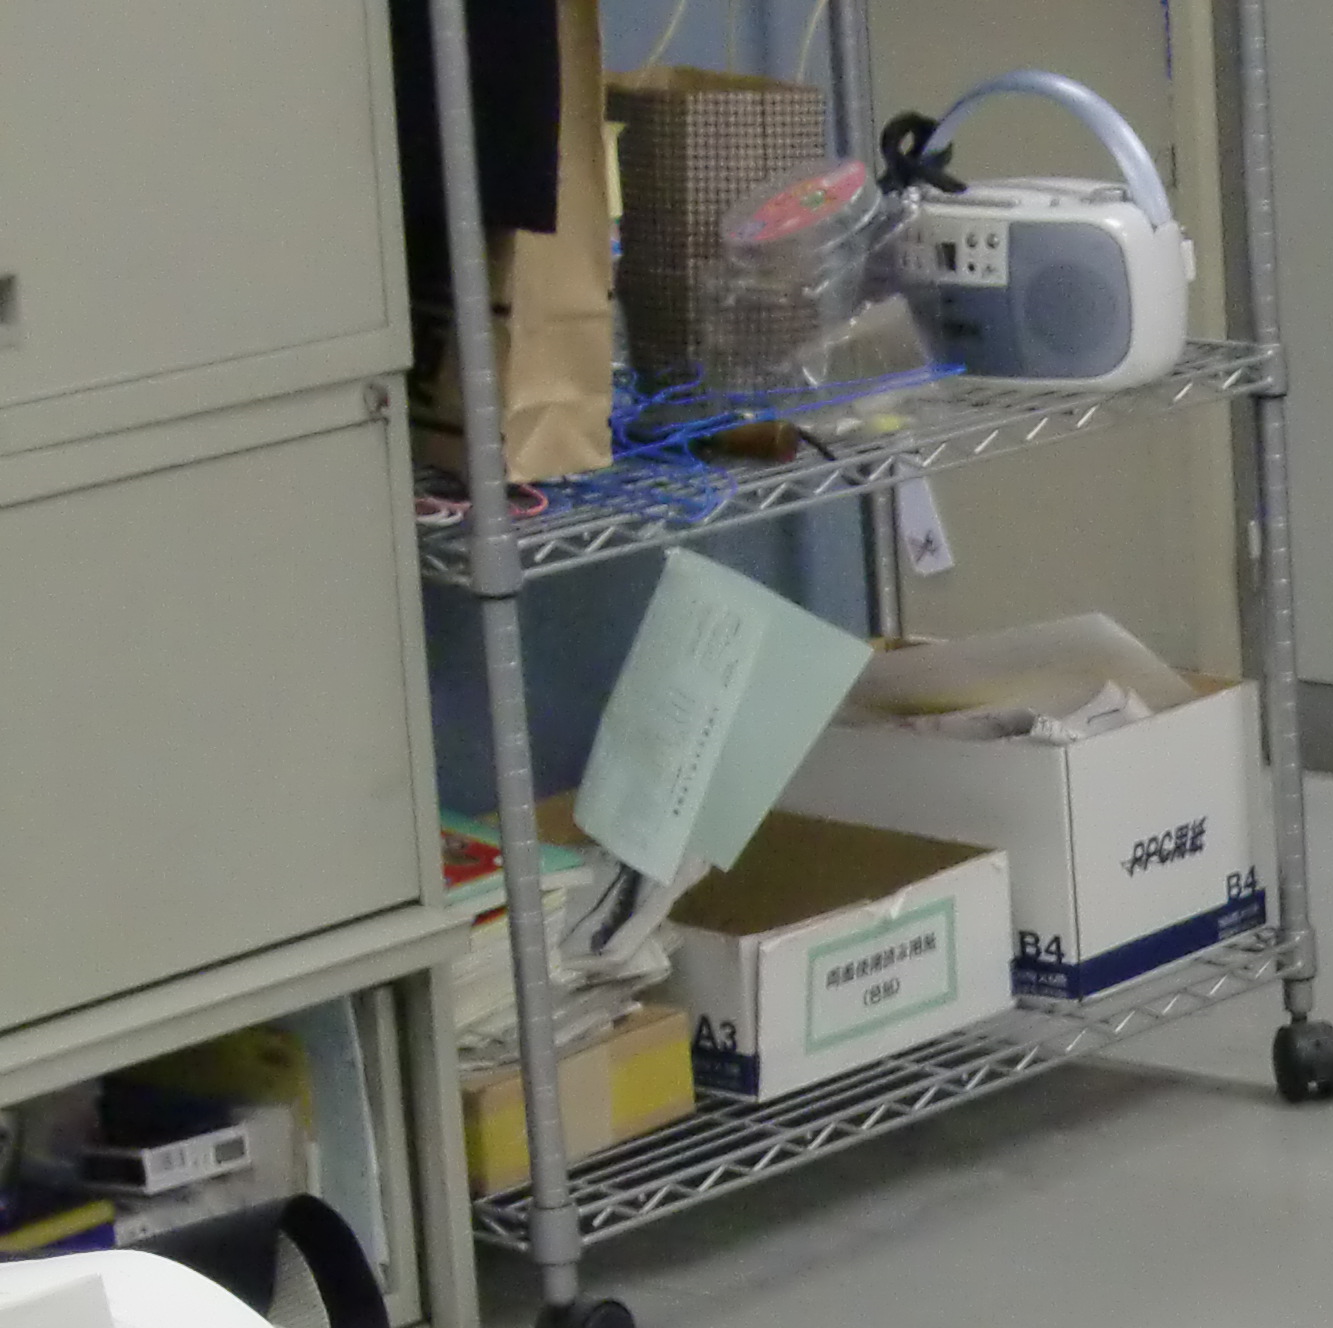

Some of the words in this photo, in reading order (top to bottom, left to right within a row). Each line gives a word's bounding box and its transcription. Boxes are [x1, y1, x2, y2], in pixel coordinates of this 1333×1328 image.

[1226, 865, 1257, 900] B4
[1018, 931, 1065, 965] B4
[694, 1014, 737, 1051] A3
